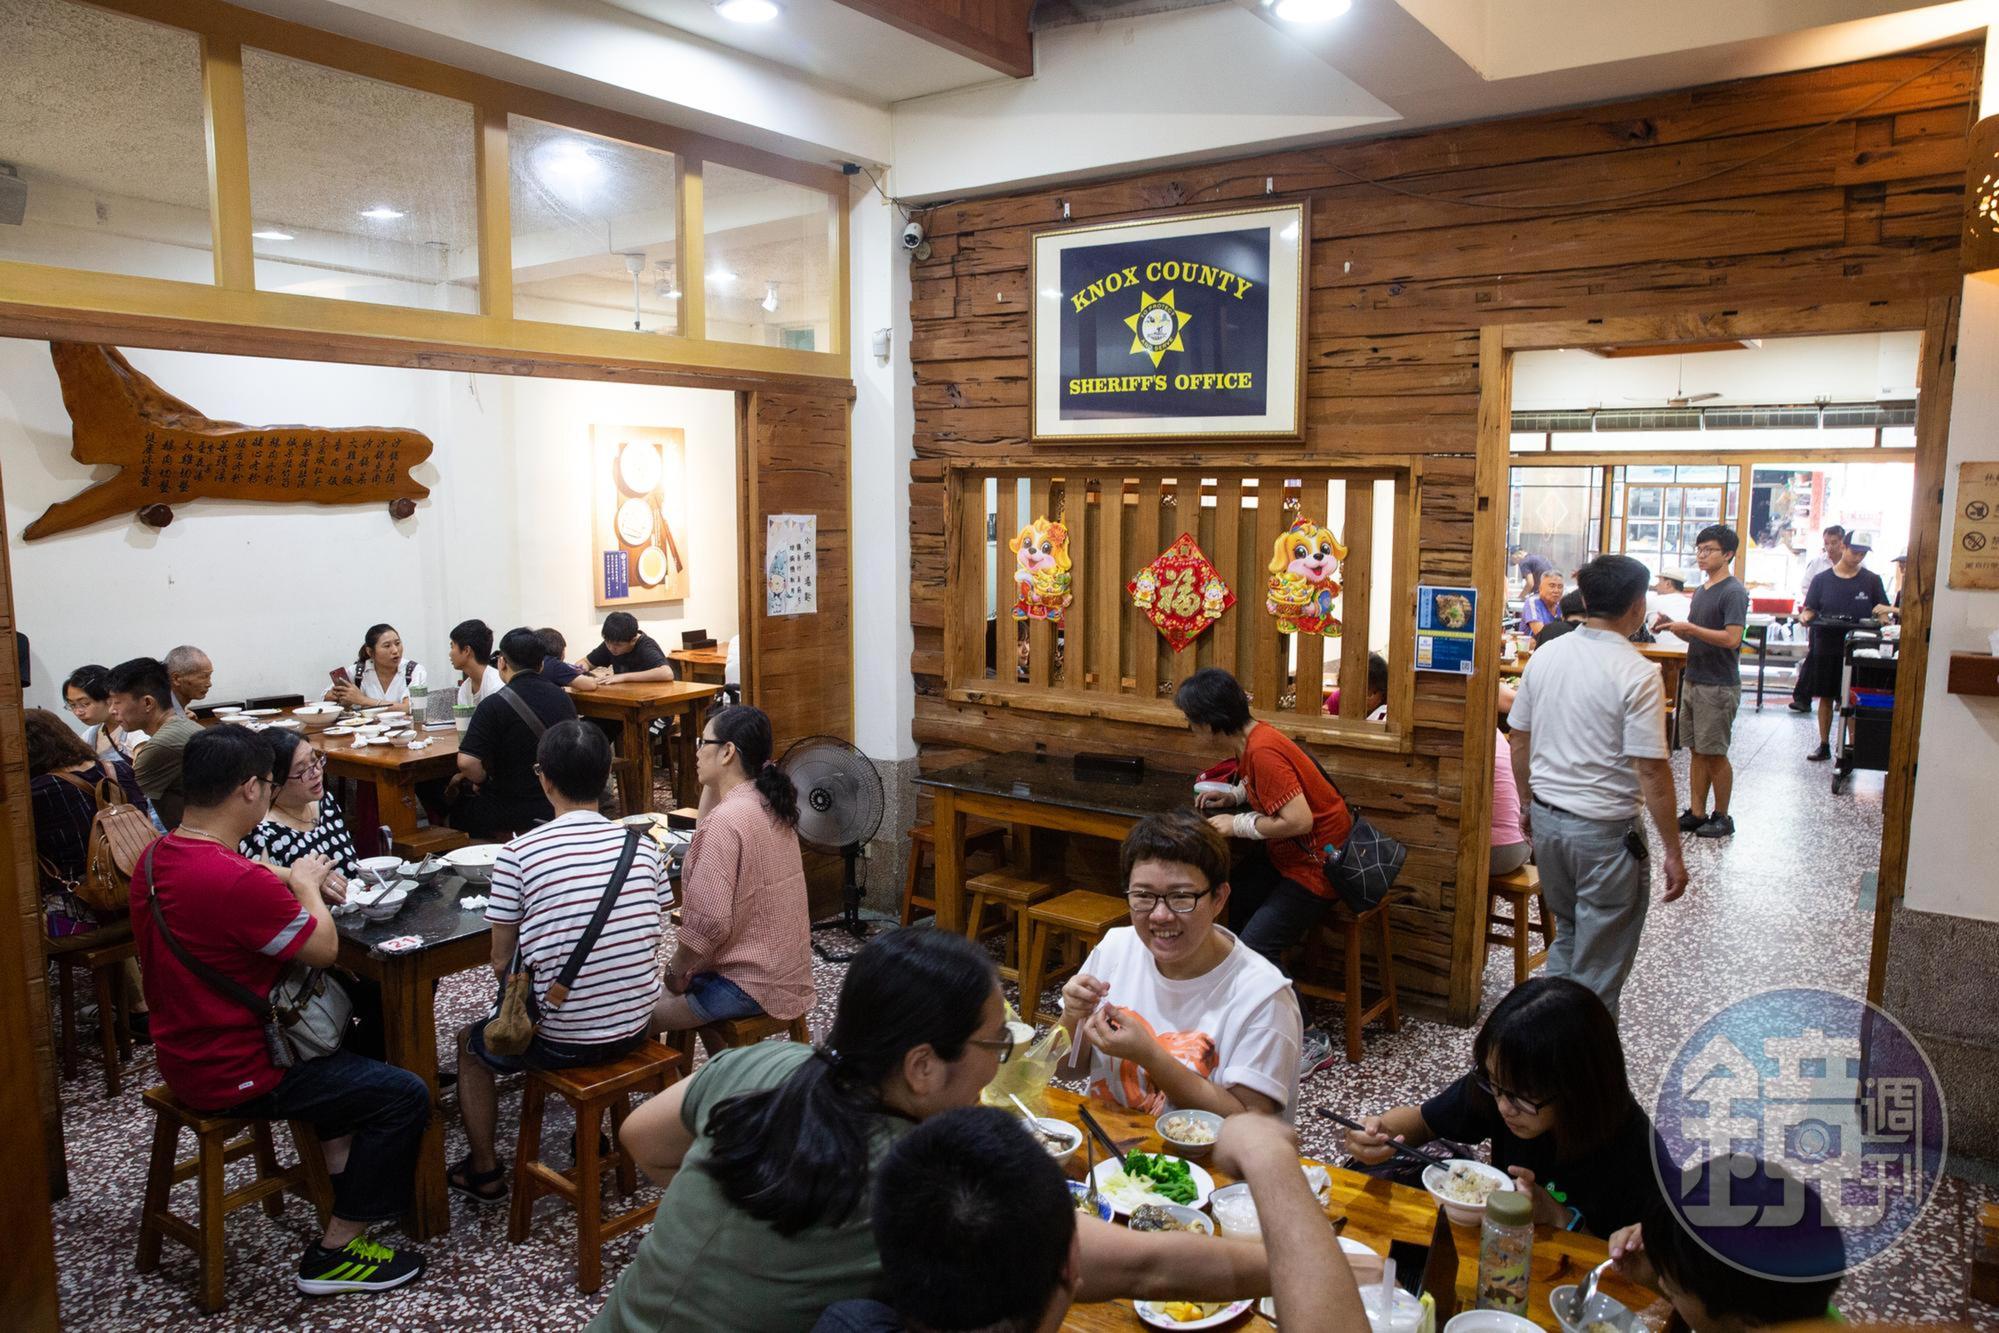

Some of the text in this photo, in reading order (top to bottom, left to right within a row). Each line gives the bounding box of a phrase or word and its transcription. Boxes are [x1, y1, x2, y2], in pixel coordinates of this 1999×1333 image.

[1070, 260, 1253, 314] KNOX COUNTY
[1069, 372, 1252, 395] SHERIFF'S OFFICE
